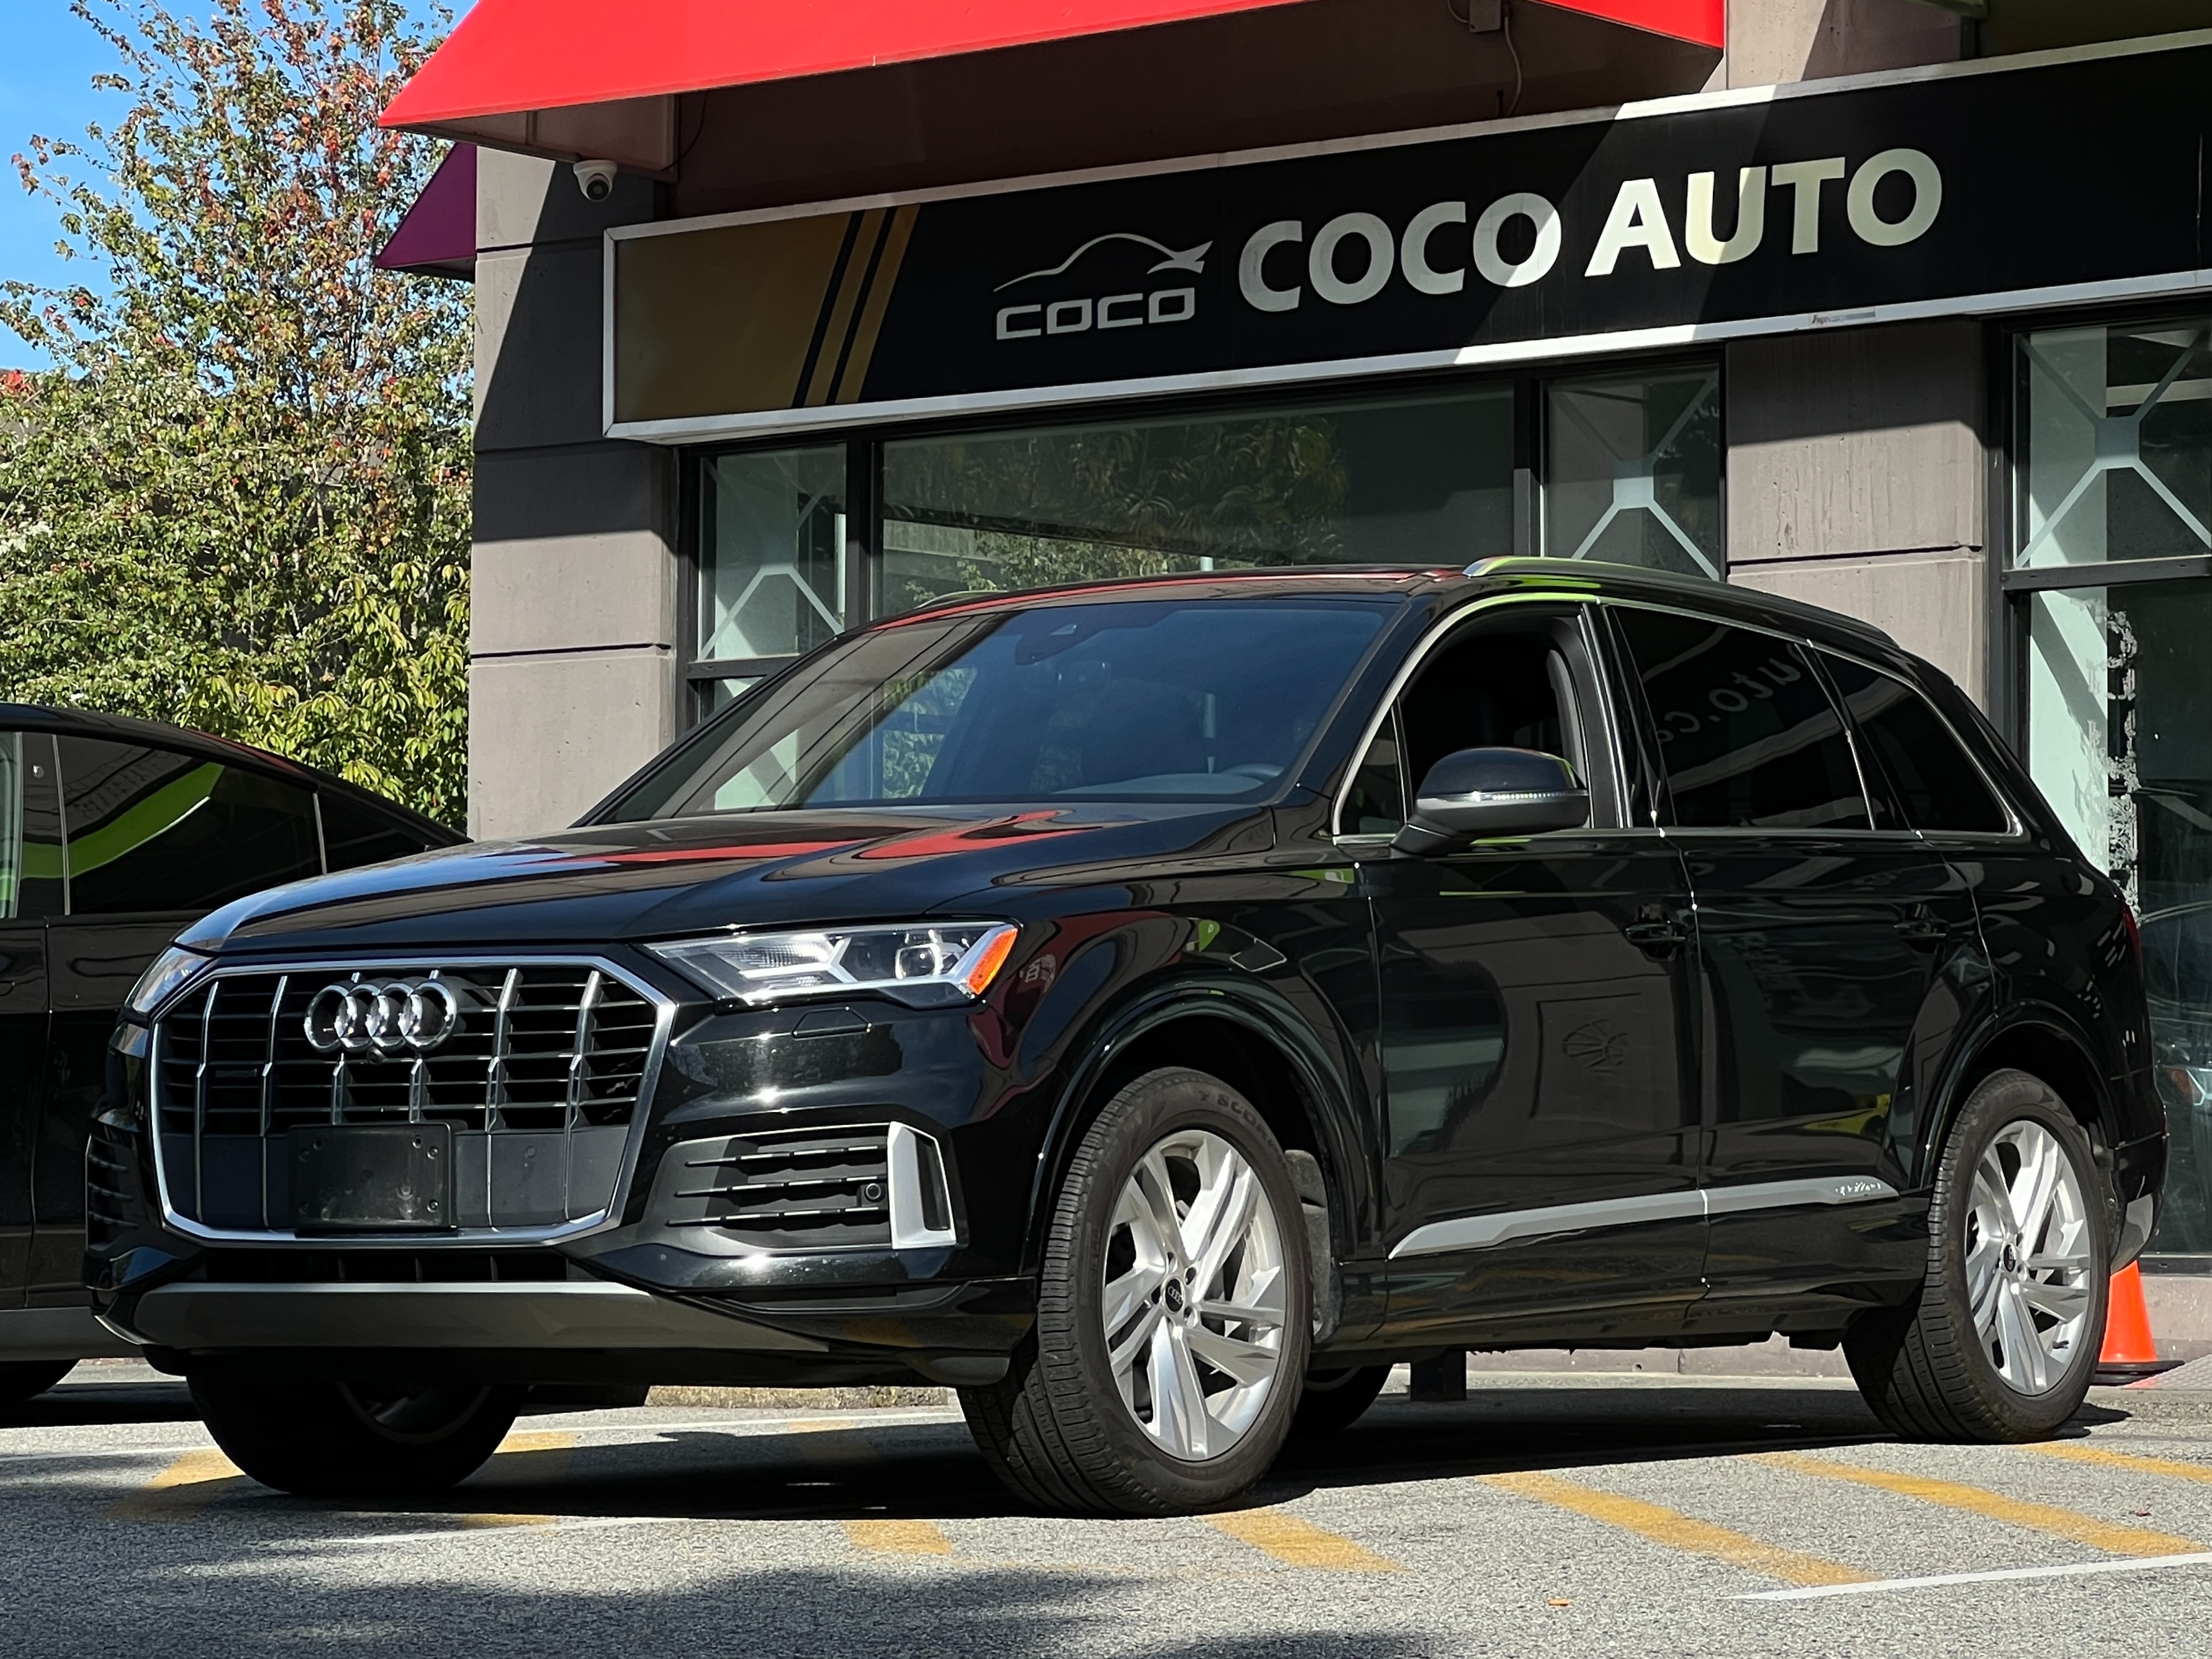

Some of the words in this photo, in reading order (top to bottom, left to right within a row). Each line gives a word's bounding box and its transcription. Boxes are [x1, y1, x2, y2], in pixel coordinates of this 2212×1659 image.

[1239, 192, 1562, 312] COCO
[1584, 148, 1943, 277] AUTO
[996, 287, 1196, 340] COCO
